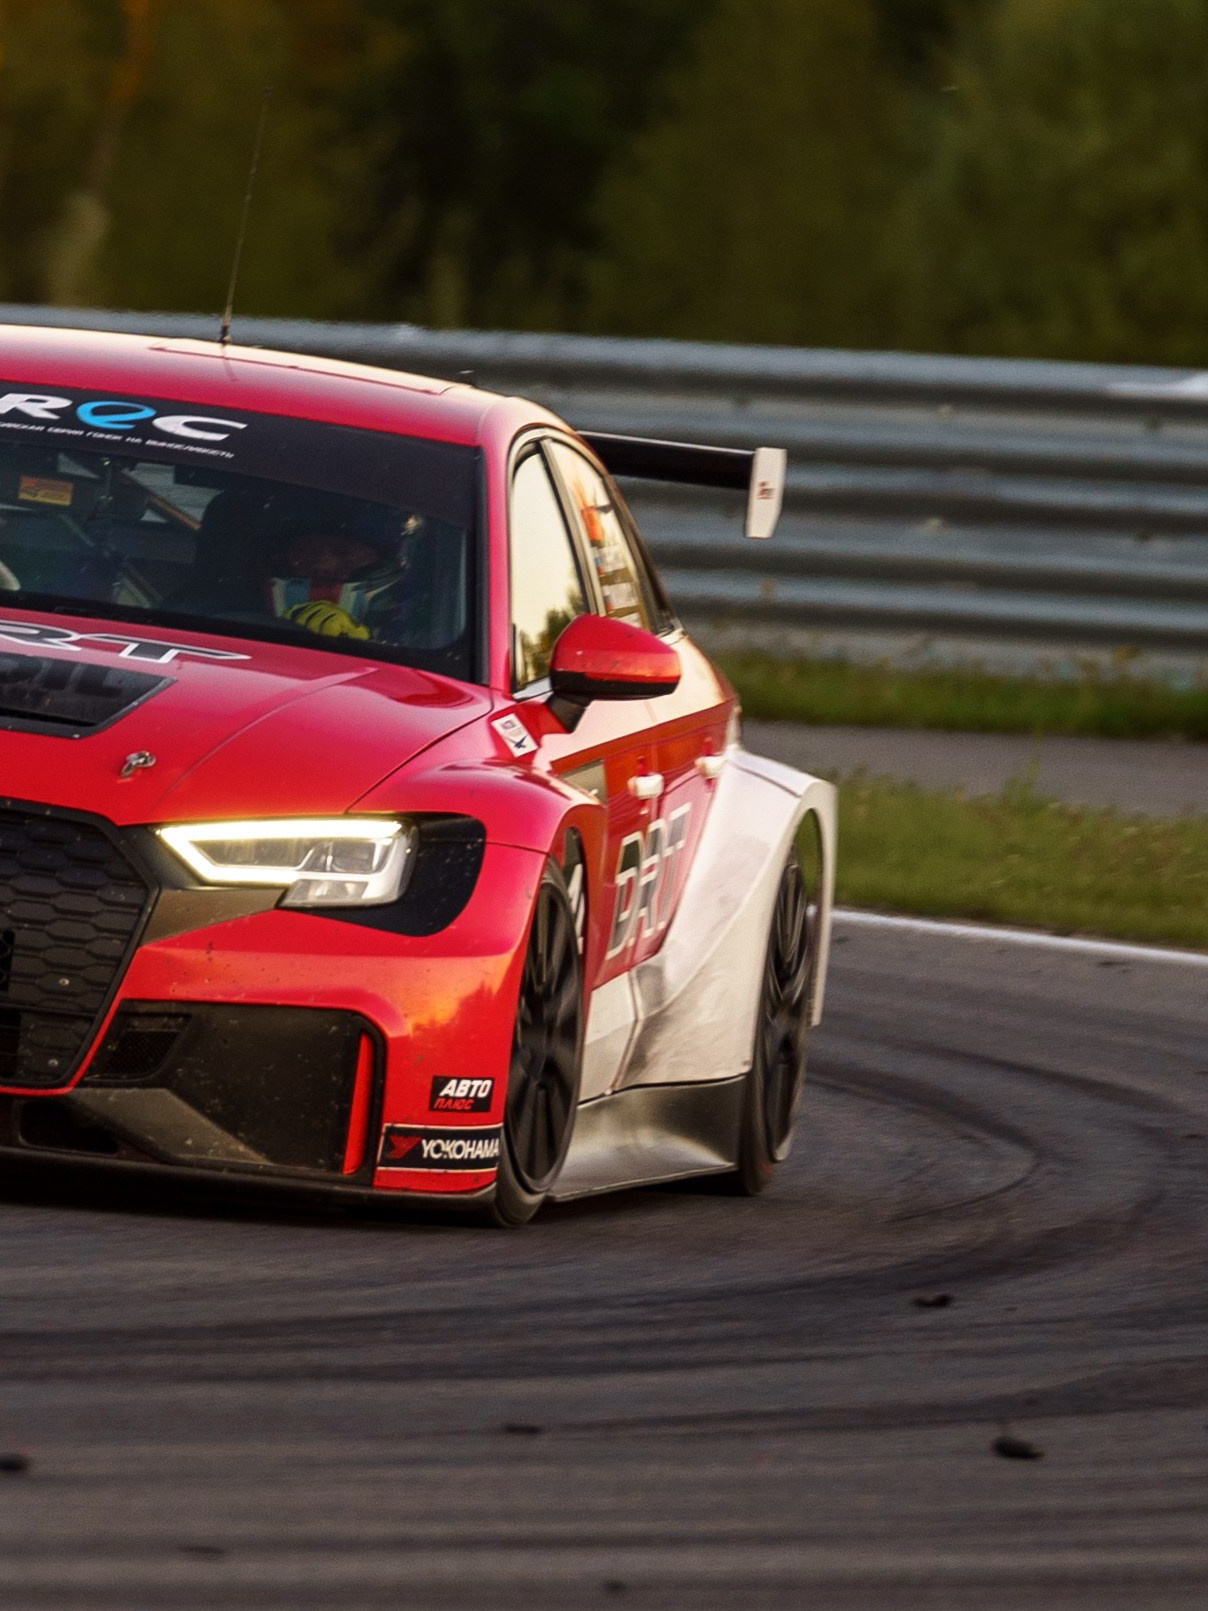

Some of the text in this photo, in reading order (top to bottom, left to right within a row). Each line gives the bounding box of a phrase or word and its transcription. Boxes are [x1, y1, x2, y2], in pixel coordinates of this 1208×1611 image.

[439, 1079, 492, 1098] АВТО
[433, 1098, 474, 1110] ПЛЮС
[421, 1138, 500, 1160] YOKOHAMA
